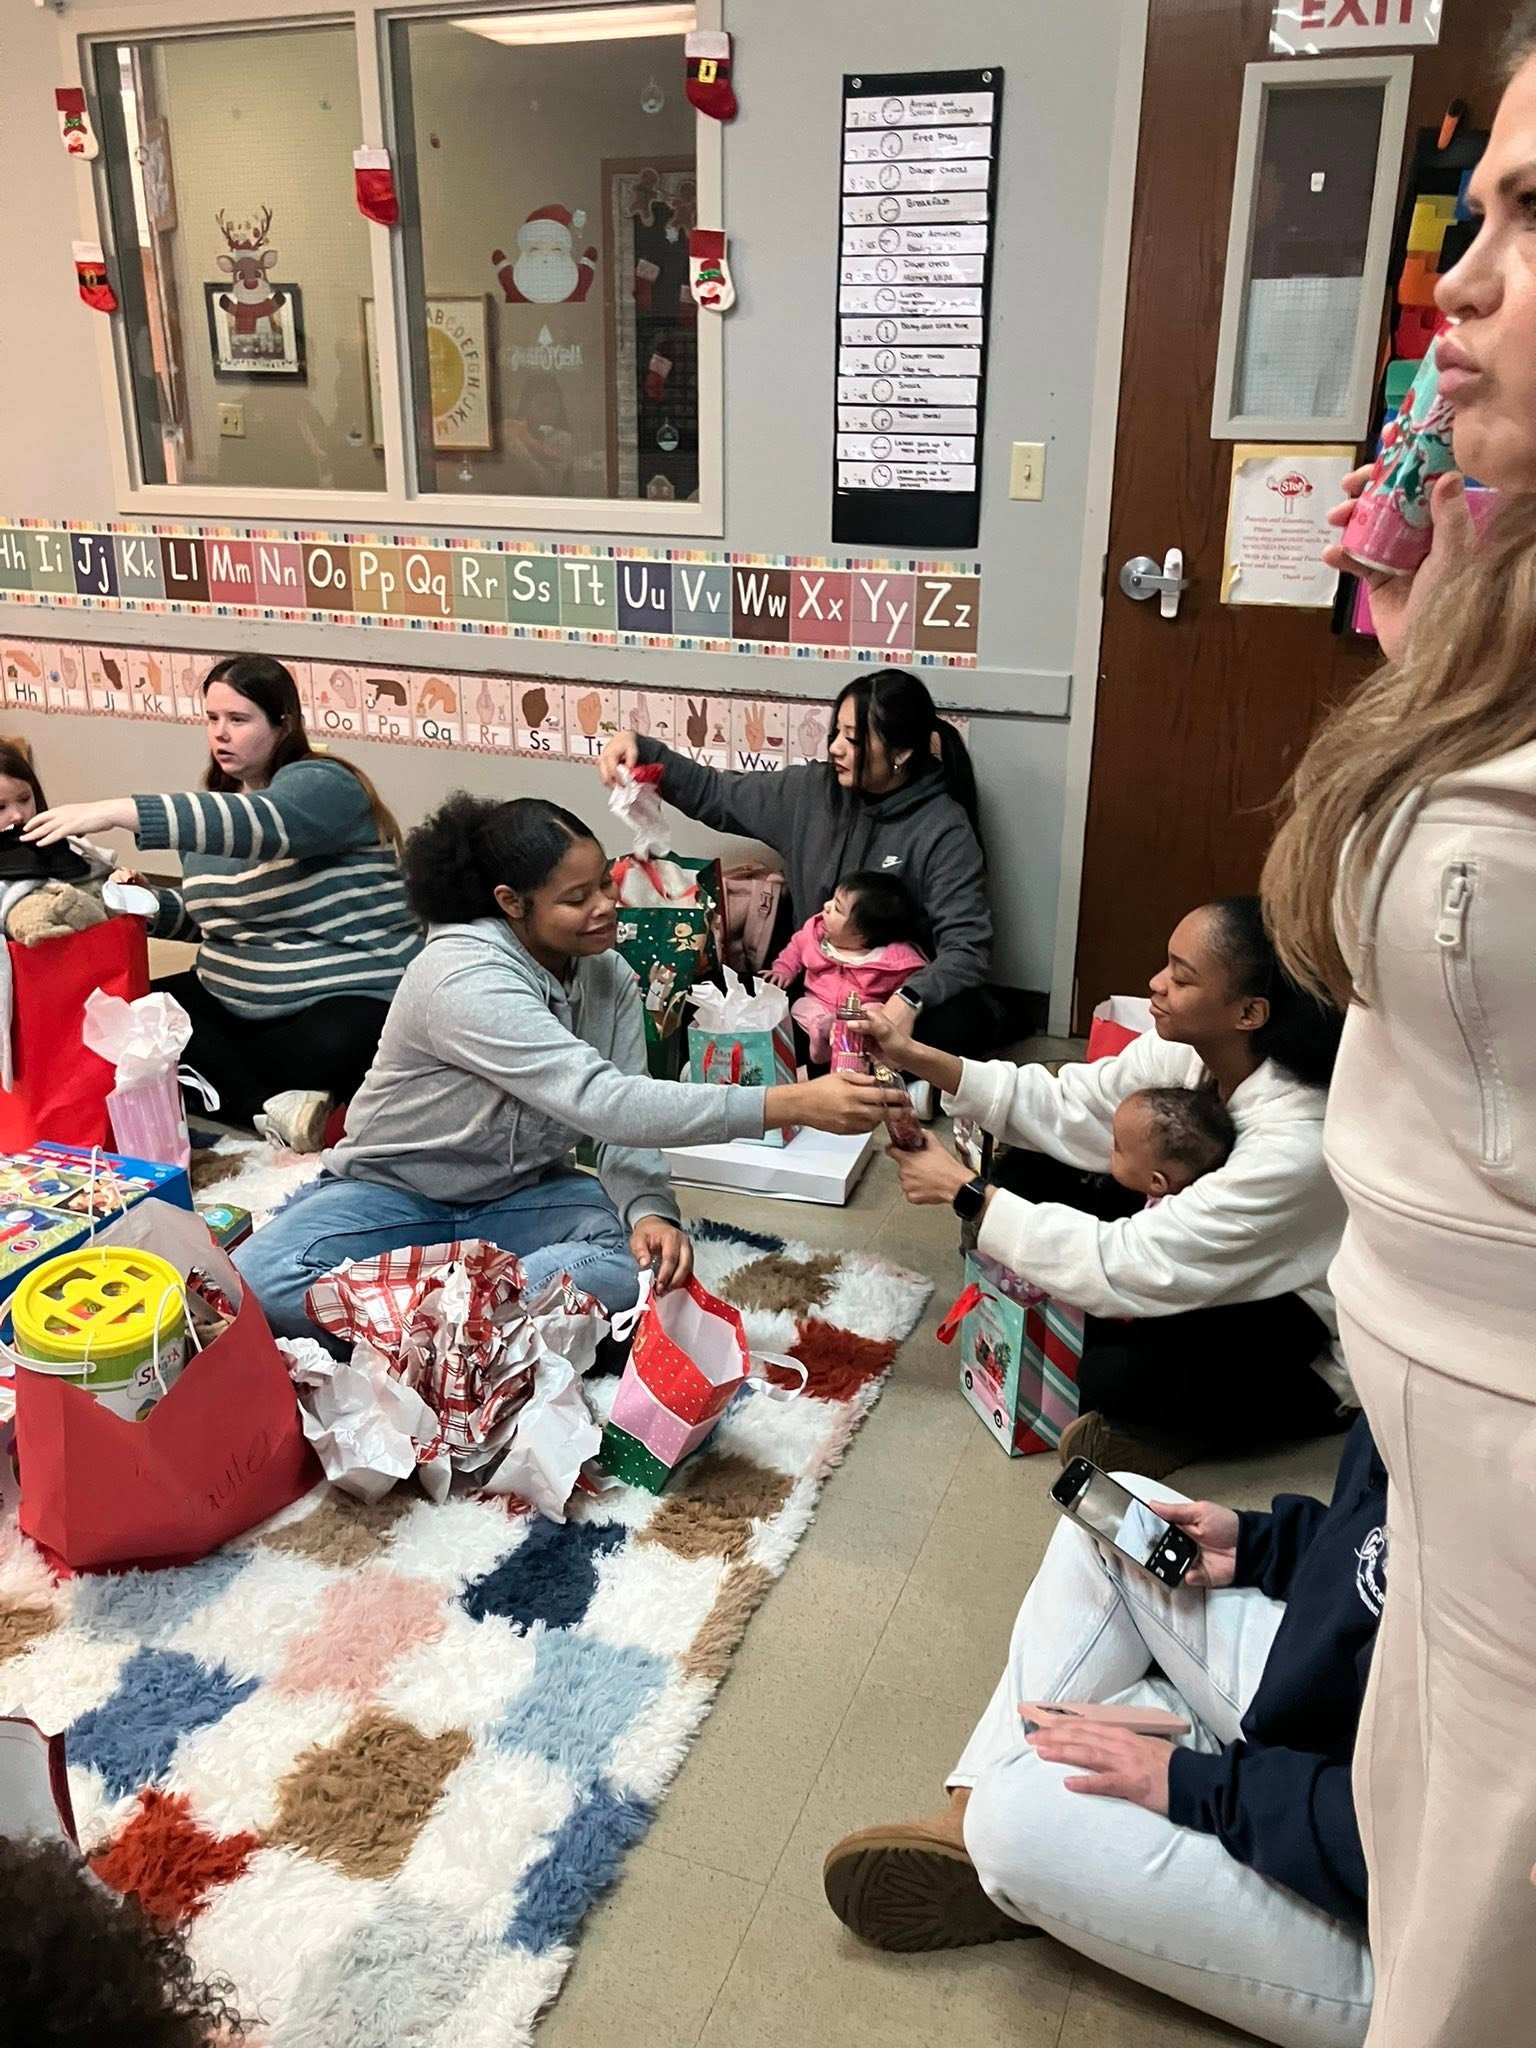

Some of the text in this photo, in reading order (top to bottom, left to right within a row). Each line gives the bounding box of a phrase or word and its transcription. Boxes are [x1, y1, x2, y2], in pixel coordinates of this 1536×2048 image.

[35, 535, 63, 573] Ii
[77, 538, 110, 594] Jj
[121, 539, 156, 579] Kk
[212, 544, 251, 585] Mm
[259, 546, 297, 587] Nn
[308, 548, 347, 589] Oo
[359, 551, 396, 610] Pp
[405, 554, 451, 615] Qq
[461, 556, 498, 599] Rr
[512, 560, 550, 603] Ss
[564, 562, 606, 607] Tt
[623, 565, 666, 611] Uu
[680, 569, 722, 613] Vv
[736, 571, 787, 618] Ww
[798, 575, 844, 622] Xx
[860, 577, 909, 644] Yy
[922, 581, 972, 628] Zz
[14, 683, 38, 703] Hh
[142, 694, 165, 714] Kk
[323, 710, 353, 731] Oo
[378, 715, 401, 736] Pp
[422, 719, 452, 745] Qq
[480, 725, 499, 745] Rr
[529, 730, 551, 752] Ss
[738, 751, 779, 771] Ww
